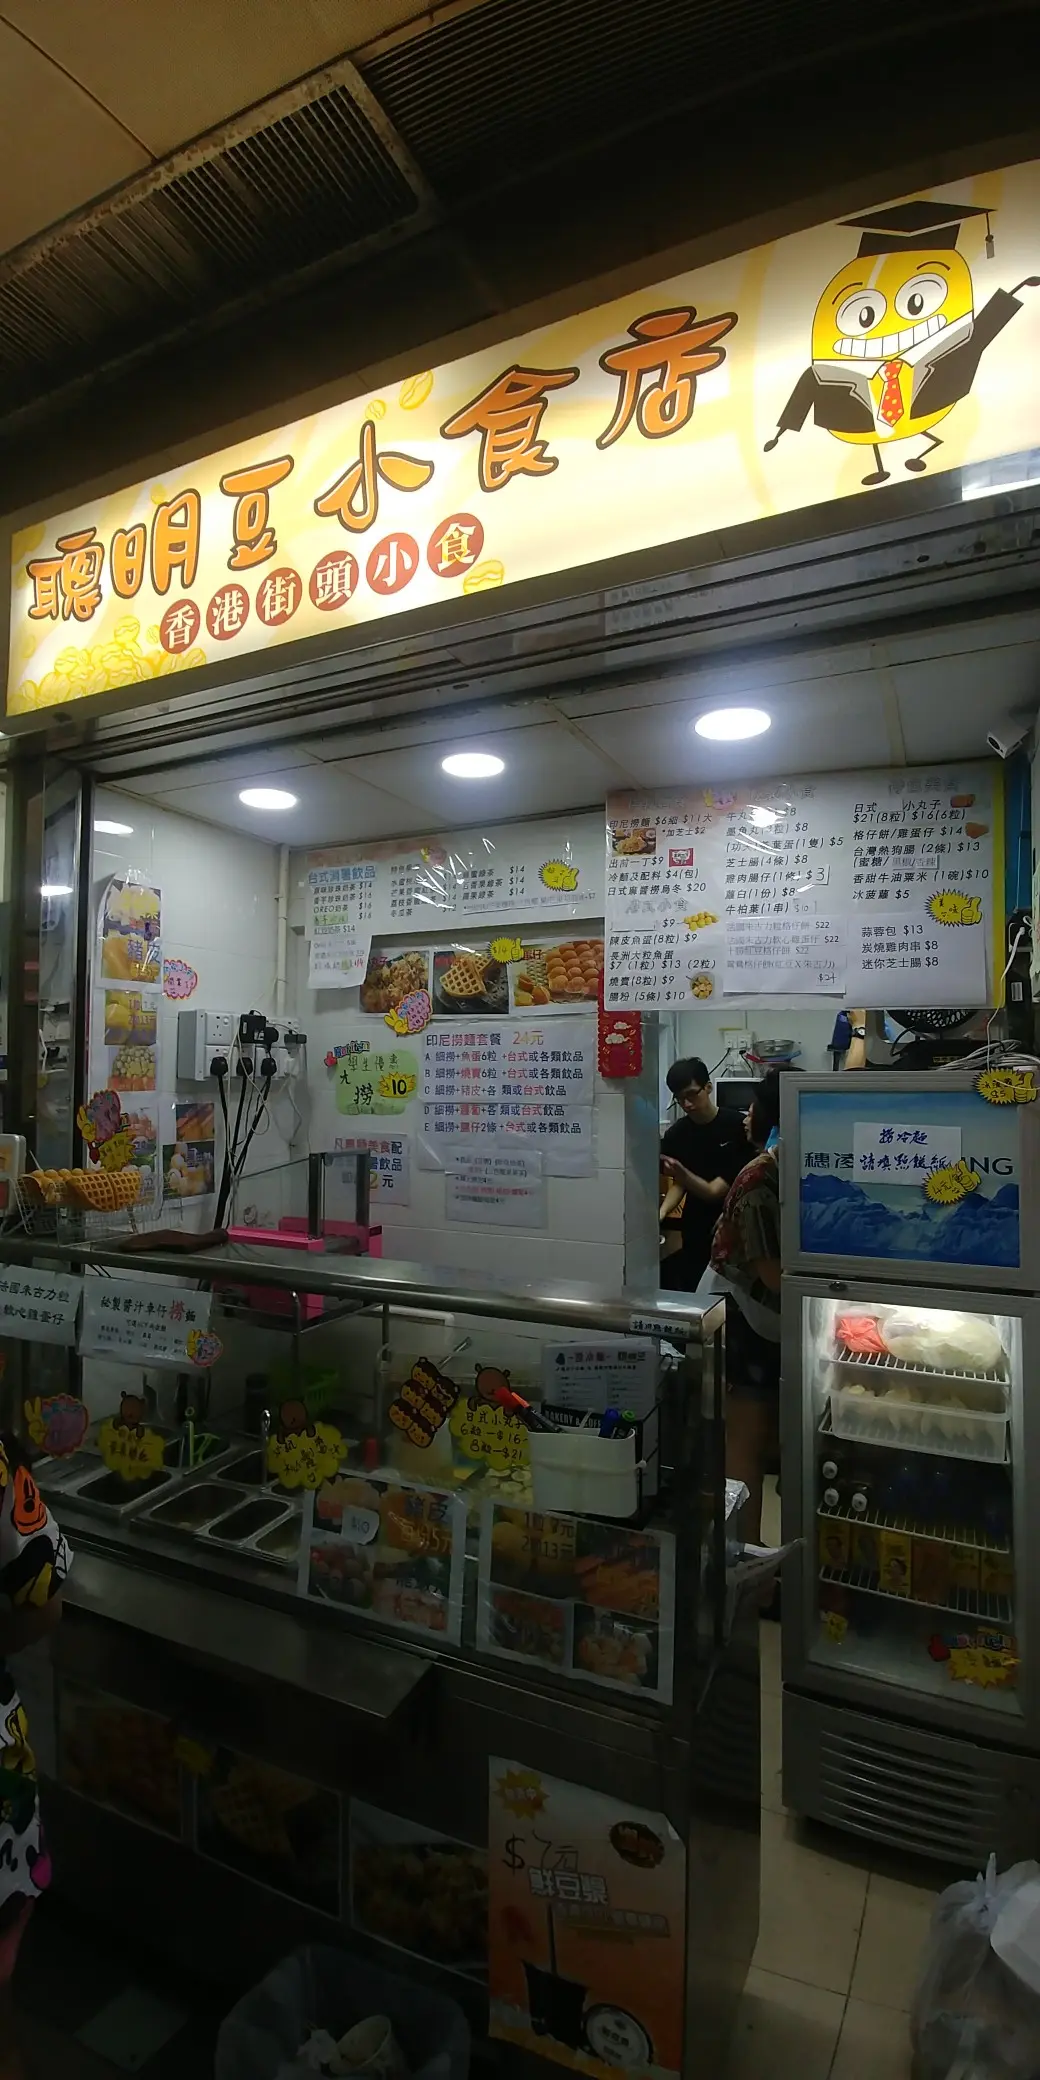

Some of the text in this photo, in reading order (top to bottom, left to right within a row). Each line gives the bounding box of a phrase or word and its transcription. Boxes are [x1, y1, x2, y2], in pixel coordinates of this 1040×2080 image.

[27, 306, 740, 622] 聰明豆小食店
[162, 516, 482, 650] 香港街頭小食
[854, 803, 877, 813] 日式
[829, 837, 844, 847] $5
[957, 842, 980, 852] $13
[686, 883, 707, 893] $20
[895, 889, 910, 899] $5
[662, 918, 676, 928] $9
[903, 925, 924, 935] $13
[684, 933, 698, 943] $9
[924, 941, 939, 950] $8
[661, 959, 681, 969] $13
[925, 957, 939, 967] $8
[661, 975, 675, 985] $9
[665, 991, 685, 1001] $10
[425, 1052, 431, 1061] A
[425, 1069, 430, 1078] B
[424, 1085, 430, 1095] C
[424, 1106, 430, 1115] D
[424, 1123, 429, 1132] E
